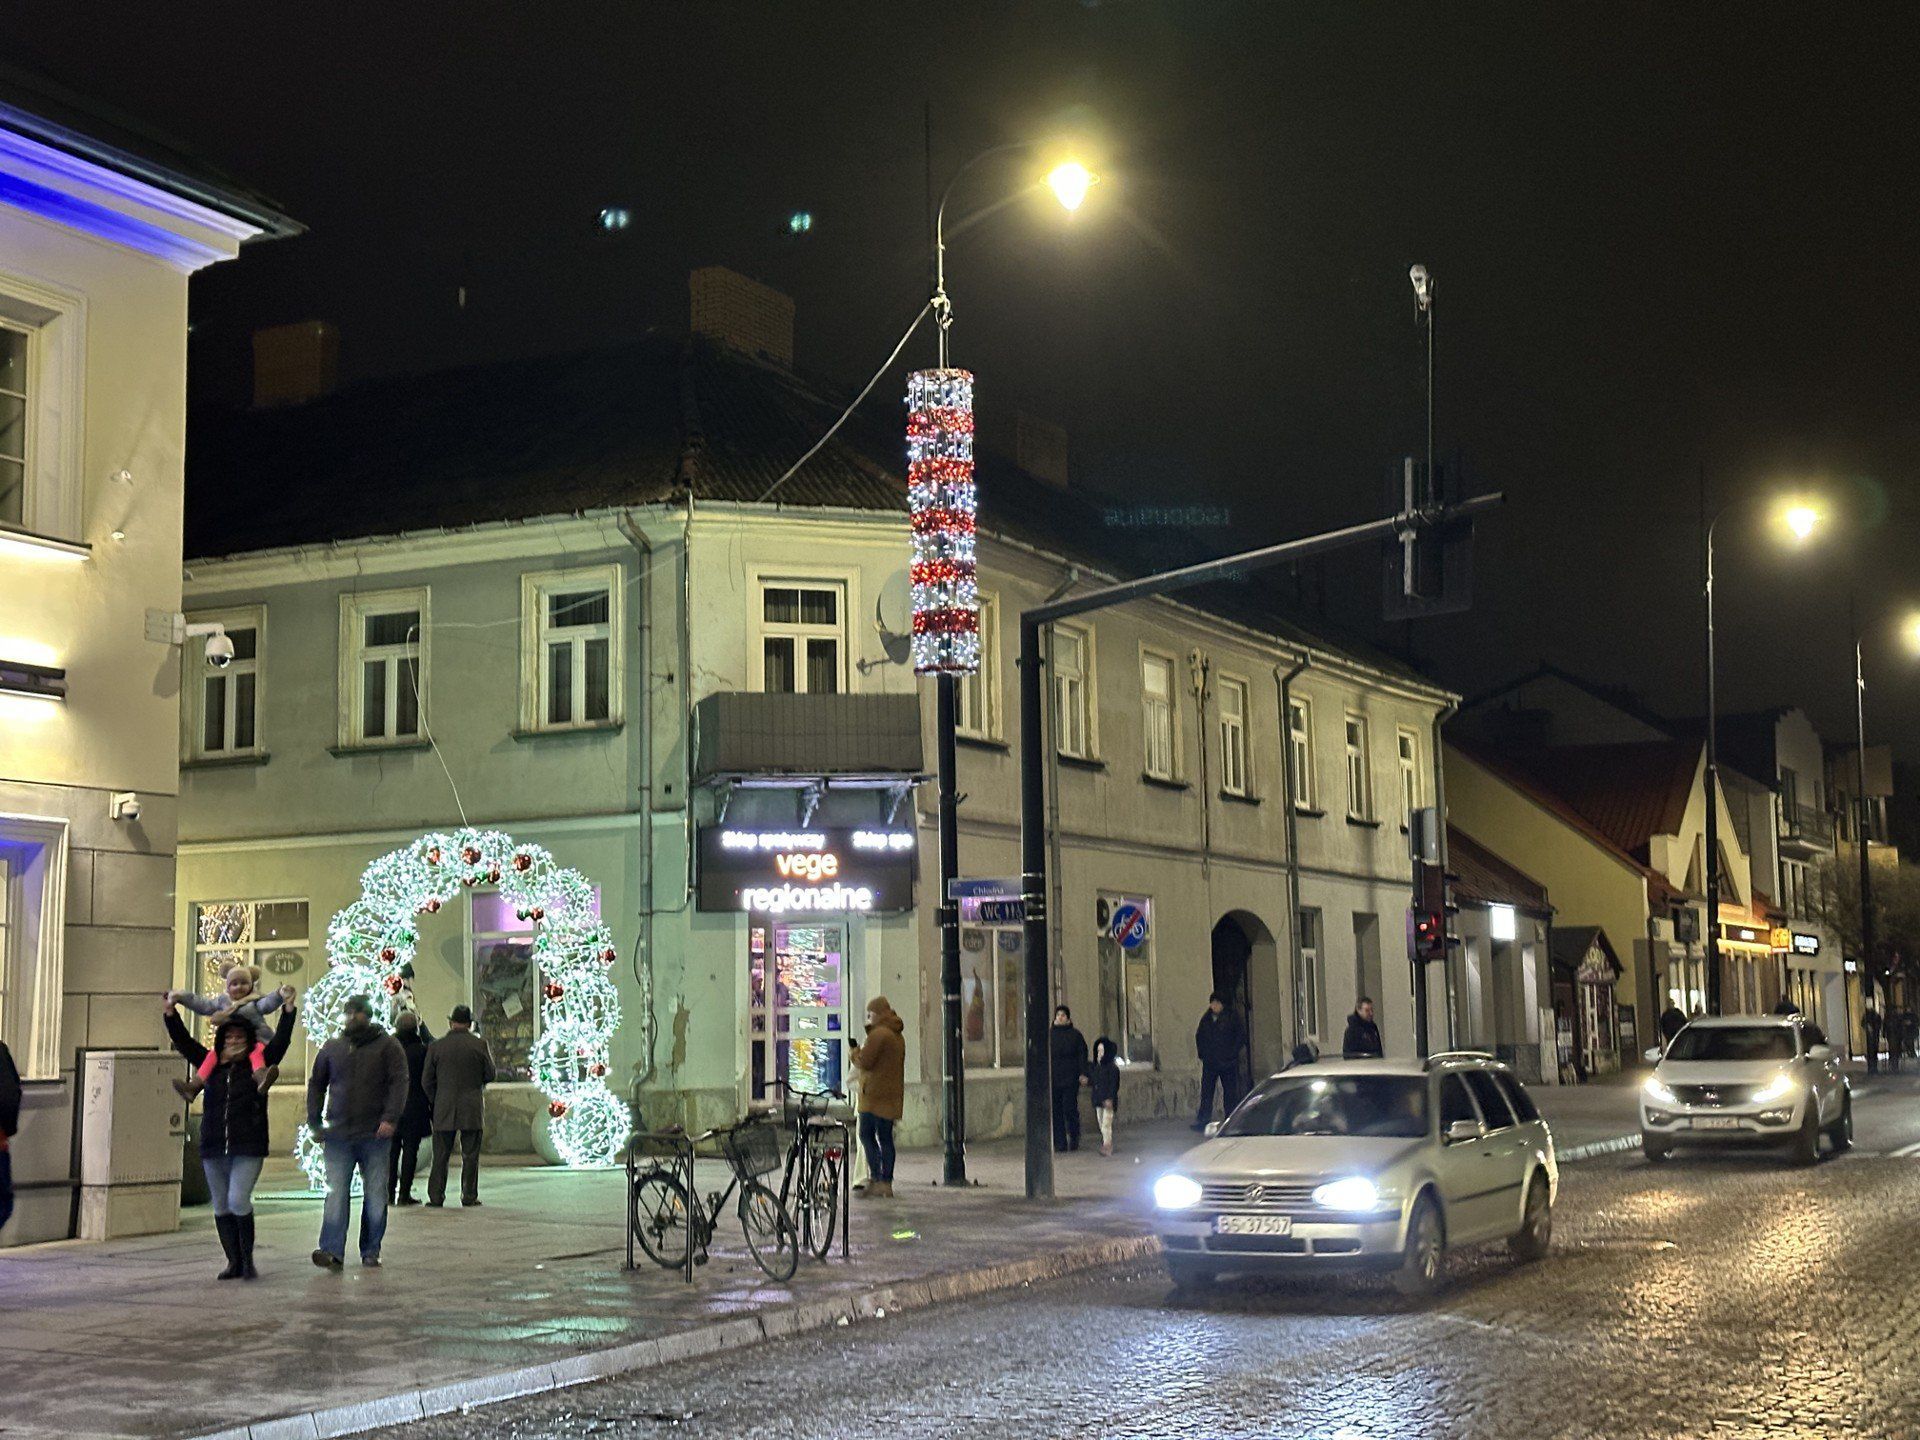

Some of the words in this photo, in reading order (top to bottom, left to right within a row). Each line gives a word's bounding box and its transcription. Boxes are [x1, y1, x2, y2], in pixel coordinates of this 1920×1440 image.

[776, 852, 838, 880] vege
[743, 882, 872, 912] regionalne
[984, 903, 1001, 920] WC
